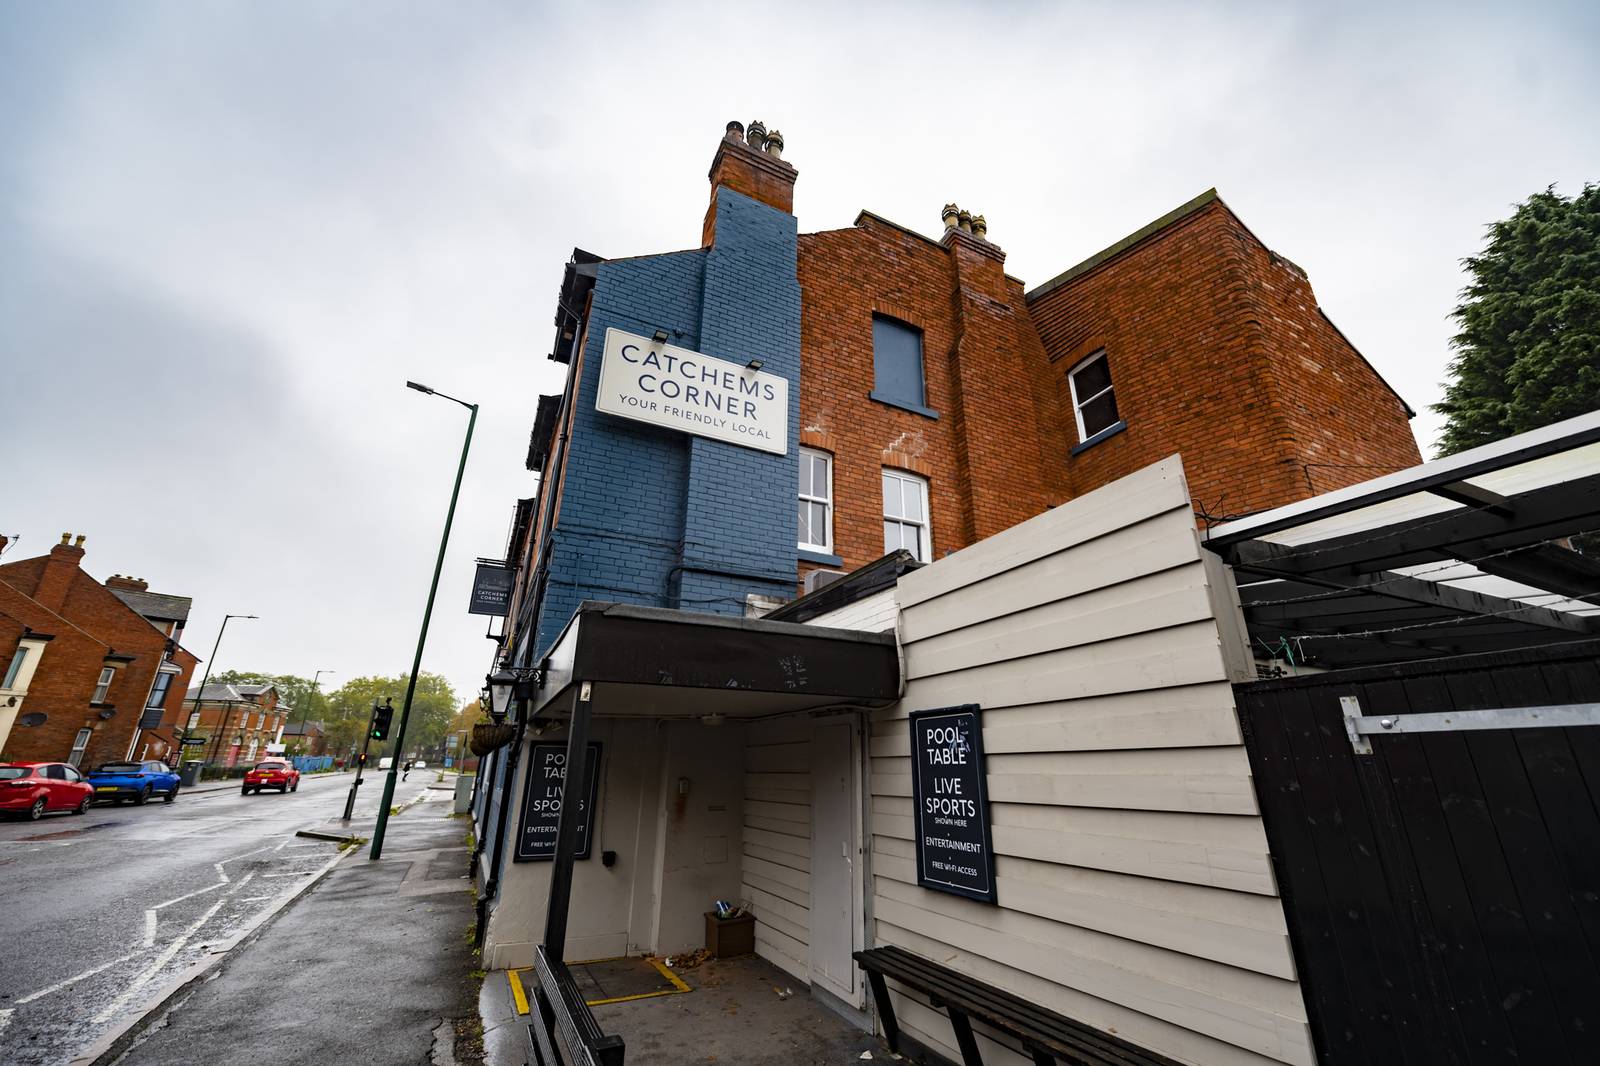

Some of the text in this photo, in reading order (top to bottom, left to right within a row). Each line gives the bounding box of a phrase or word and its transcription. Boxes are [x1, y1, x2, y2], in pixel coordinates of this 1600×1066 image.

[621, 345, 775, 400] CATCHEMS
[638, 374, 757, 420] CORNER
[619, 394, 770, 439] YOUR FRIENDLY LOCAL
[926, 726, 963, 745] POOL
[546, 754, 565, 765] PO
[926, 748, 967, 765] TABLE
[544, 767, 567, 778] TAB
[934, 777, 962, 795] LIVE
[533, 800, 585, 811] SPOS
[926, 797, 976, 817] SPORTS
[527, 825, 584, 833] ENTERTAT
[934, 817, 967, 828] SHOWN HERE
[925, 836, 981, 854] ENTERTAINMENT
[932, 861, 944, 870] FREE
[957, 867, 978, 877] ACCESS
